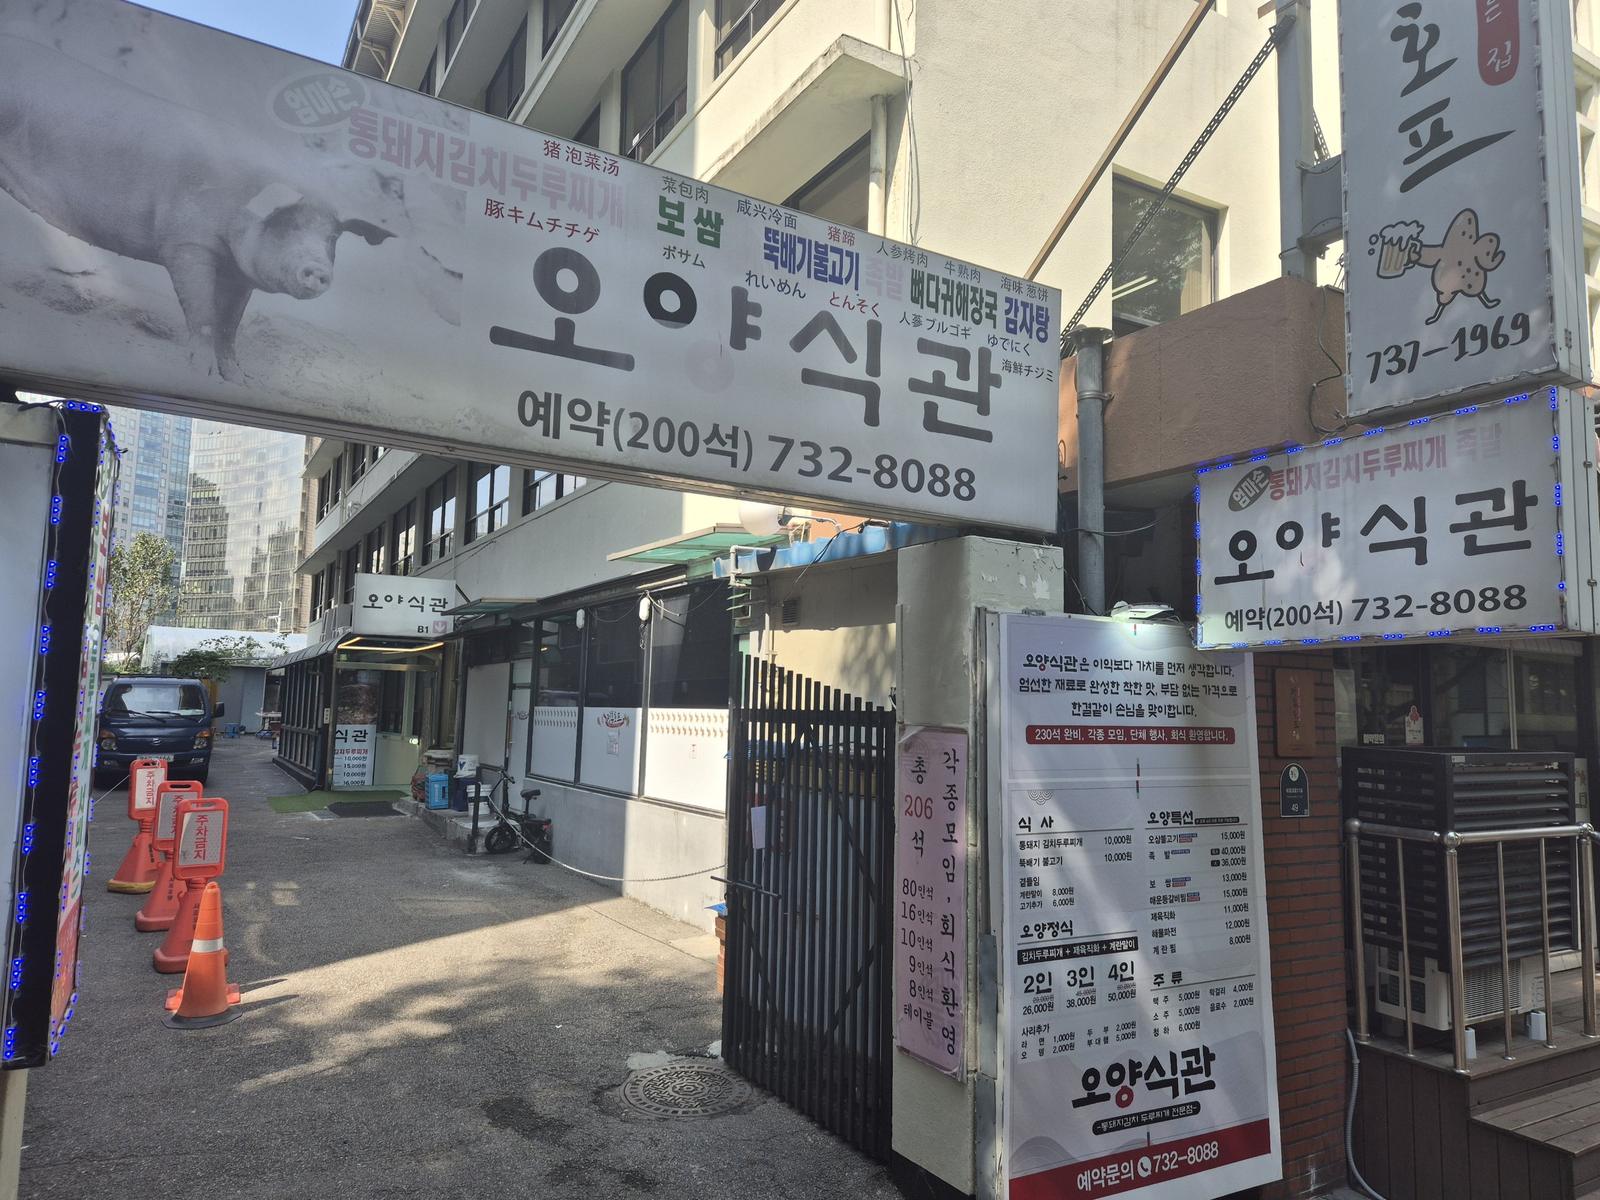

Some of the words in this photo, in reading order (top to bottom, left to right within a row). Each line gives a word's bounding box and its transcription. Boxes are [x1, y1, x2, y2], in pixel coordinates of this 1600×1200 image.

[543, 139, 620, 177] 猪泡菜汤
[484, 198, 600, 243] 豚キムチチゲ
[656, 195, 724, 250] 보쌈
[736, 198, 799, 230] 咸兴冷面
[763, 226, 860, 292] 뚝배기불고기
[745, 270, 807, 299] れいめん
[829, 291, 880, 317] とんそく
[910, 268, 998, 330] 뼈다귀해장국
[1004, 295, 1050, 344] 감자탕
[987, 333, 1032, 357] ゆでにく
[1366, 312, 1530, 383] 737-1969
[517, 388, 754, 473] 예약(200석)
[767, 433, 977, 503] 732-8088
[1268, 435, 1447, 502] 통돼지김치두루찌개
[1225, 600, 1343, 632] 예약(200석)
[1351, 584, 1528, 622] 732-8088
[417, 625, 429, 634] B1
[1093, 658, 1133, 673] 이익보다
[1136, 660, 1164, 676] 가치를
[1167, 662, 1185, 676] 먼저
[1188, 662, 1235, 678] 생각합니다.
[1019, 677, 1052, 693] 엄선한
[1054, 678, 1087, 691] 재료로
[1089, 680, 1120, 695] 완성한
[1123, 680, 1143, 696] 착한
[1161, 682, 1180, 697] 부담
[1182, 683, 1200, 698] 없는
[1202, 685, 1238, 699] 가격으로
[1071, 701, 1112, 717] 한결같이
[1115, 703, 1145, 718] 손님을
[1148, 703, 1197, 719] 맞이합니다.
[1035, 728, 1060, 740] 230석
[1087, 729, 1104, 741] 각종
[1130, 729, 1147, 741] 단체
[1171, 730, 1186, 741] 회식
[1147, 811, 1194, 826] 오양특선
[193, 814, 209, 861] 주차금지
[1019, 840, 1040, 850] 통돼지
[1104, 834, 1132, 845] 10,000원
[1221, 830, 1246, 841] 15,000원
[1019, 857, 1040, 868] 뚝배기
[1043, 856, 1063, 867] 불고기
[1104, 852, 1132, 863] 10,000원
[1221, 845, 1246, 856] 40,000원
[1221, 856, 1247, 867] 36,000원
[1222, 872, 1247, 883] 13,000원
[902, 878, 934, 899] 80인석
[1052, 886, 1074, 897] 8,000원
[1223, 887, 1248, 898] 15,000원
[901, 901, 933, 925] 16인석
[1052, 898, 1075, 908] 6,000원
[1224, 903, 1249, 914] 11,000원
[1020, 920, 1073, 939] 오양정식
[1225, 919, 1250, 930] 12,000원
[901, 927, 933, 951] 10인석
[1229, 935, 1251, 945] 8,000원
[909, 955, 933, 976] 9인석
[1023, 971, 1052, 994] 2인
[1066, 966, 1094, 988] 3인
[1107, 961, 1135, 982] 4인
[909, 979, 933, 1004] 8인석
[1022, 1001, 1054, 1016] 26,000원
[1066, 995, 1097, 1009] 38,000원
[1107, 988, 1137, 1002] 50,000원
[1178, 990, 1200, 1002] 5,000원
[1232, 982, 1254, 993] 4,000원
[903, 1003, 934, 1030] 테이블
[1178, 1005, 1200, 1017] 5,000원
[1233, 997, 1254, 1008] 2,000원
[1116, 1021, 1137, 1031] 2,000원
[1116, 1031, 1137, 1042] 5,000원
[1178, 1020, 1200, 1032] 6,000원
[1053, 1032, 1075, 1043] 1,000원
[1053, 1042, 1075, 1054] 2,000원
[1071, 1044, 1216, 1109] 오양식관
[1077, 1162, 1134, 1192] 예약문의
[1153, 1140, 1219, 1172] 732-8088
